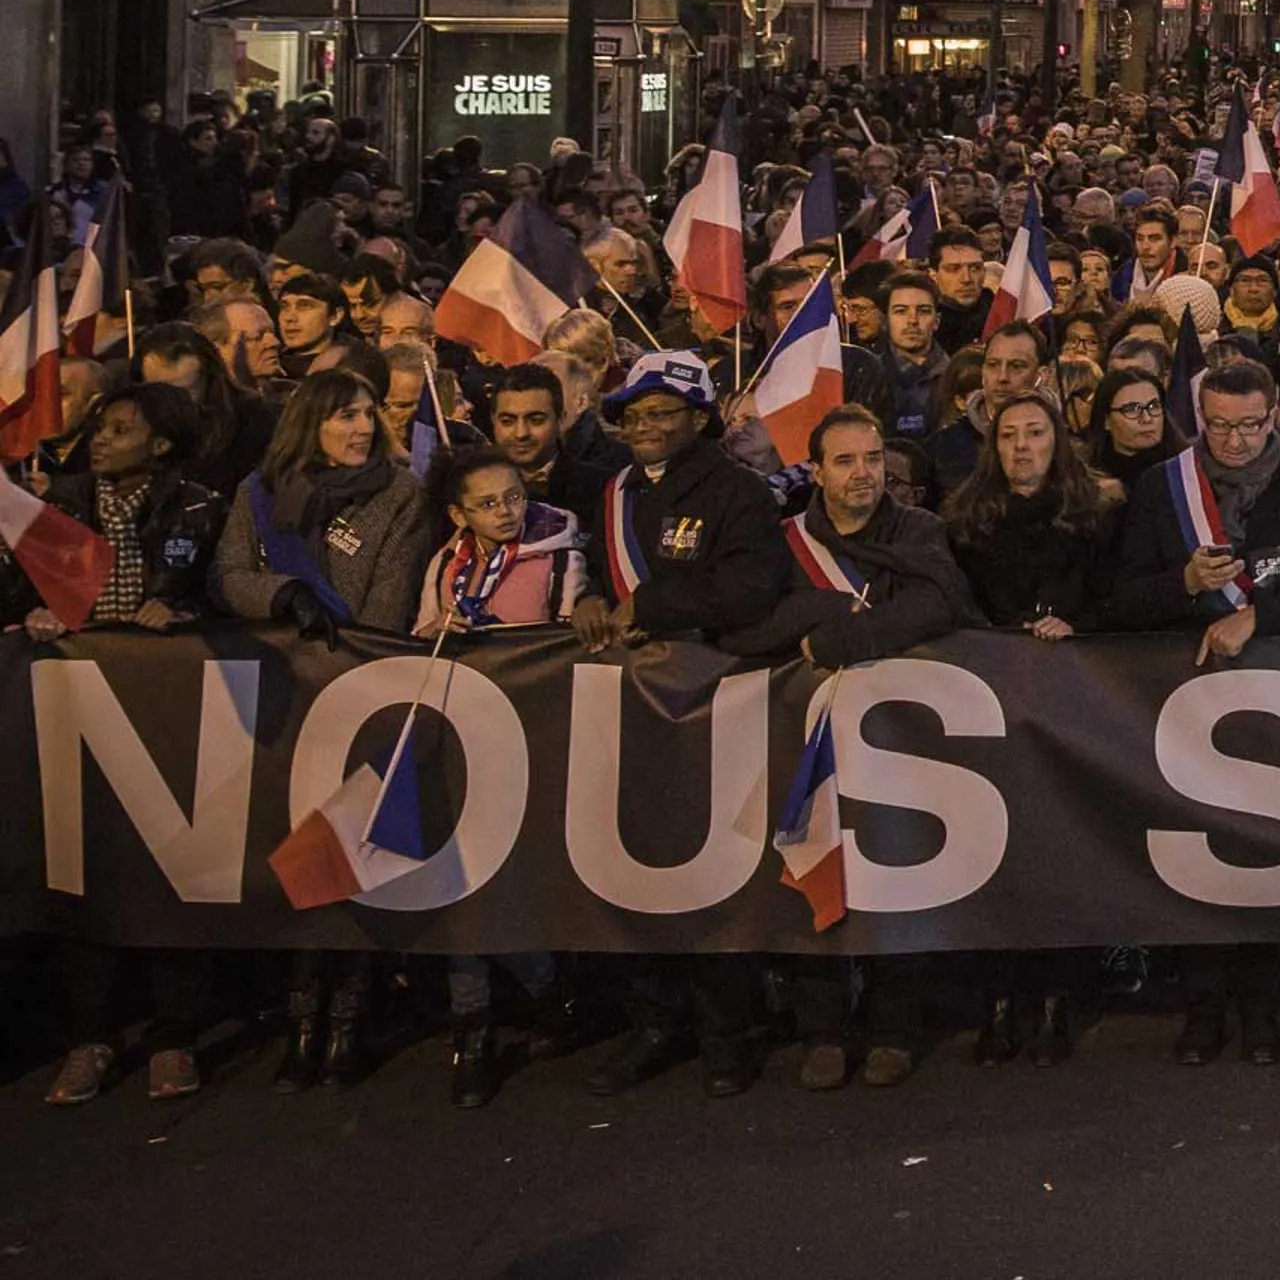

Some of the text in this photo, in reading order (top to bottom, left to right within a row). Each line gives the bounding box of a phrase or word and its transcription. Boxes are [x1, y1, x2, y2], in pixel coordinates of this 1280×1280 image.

[454, 74, 552, 93] JE SUIS
[454, 92, 552, 116] CHARLIE
[33, 655, 1009, 914] NOUS
